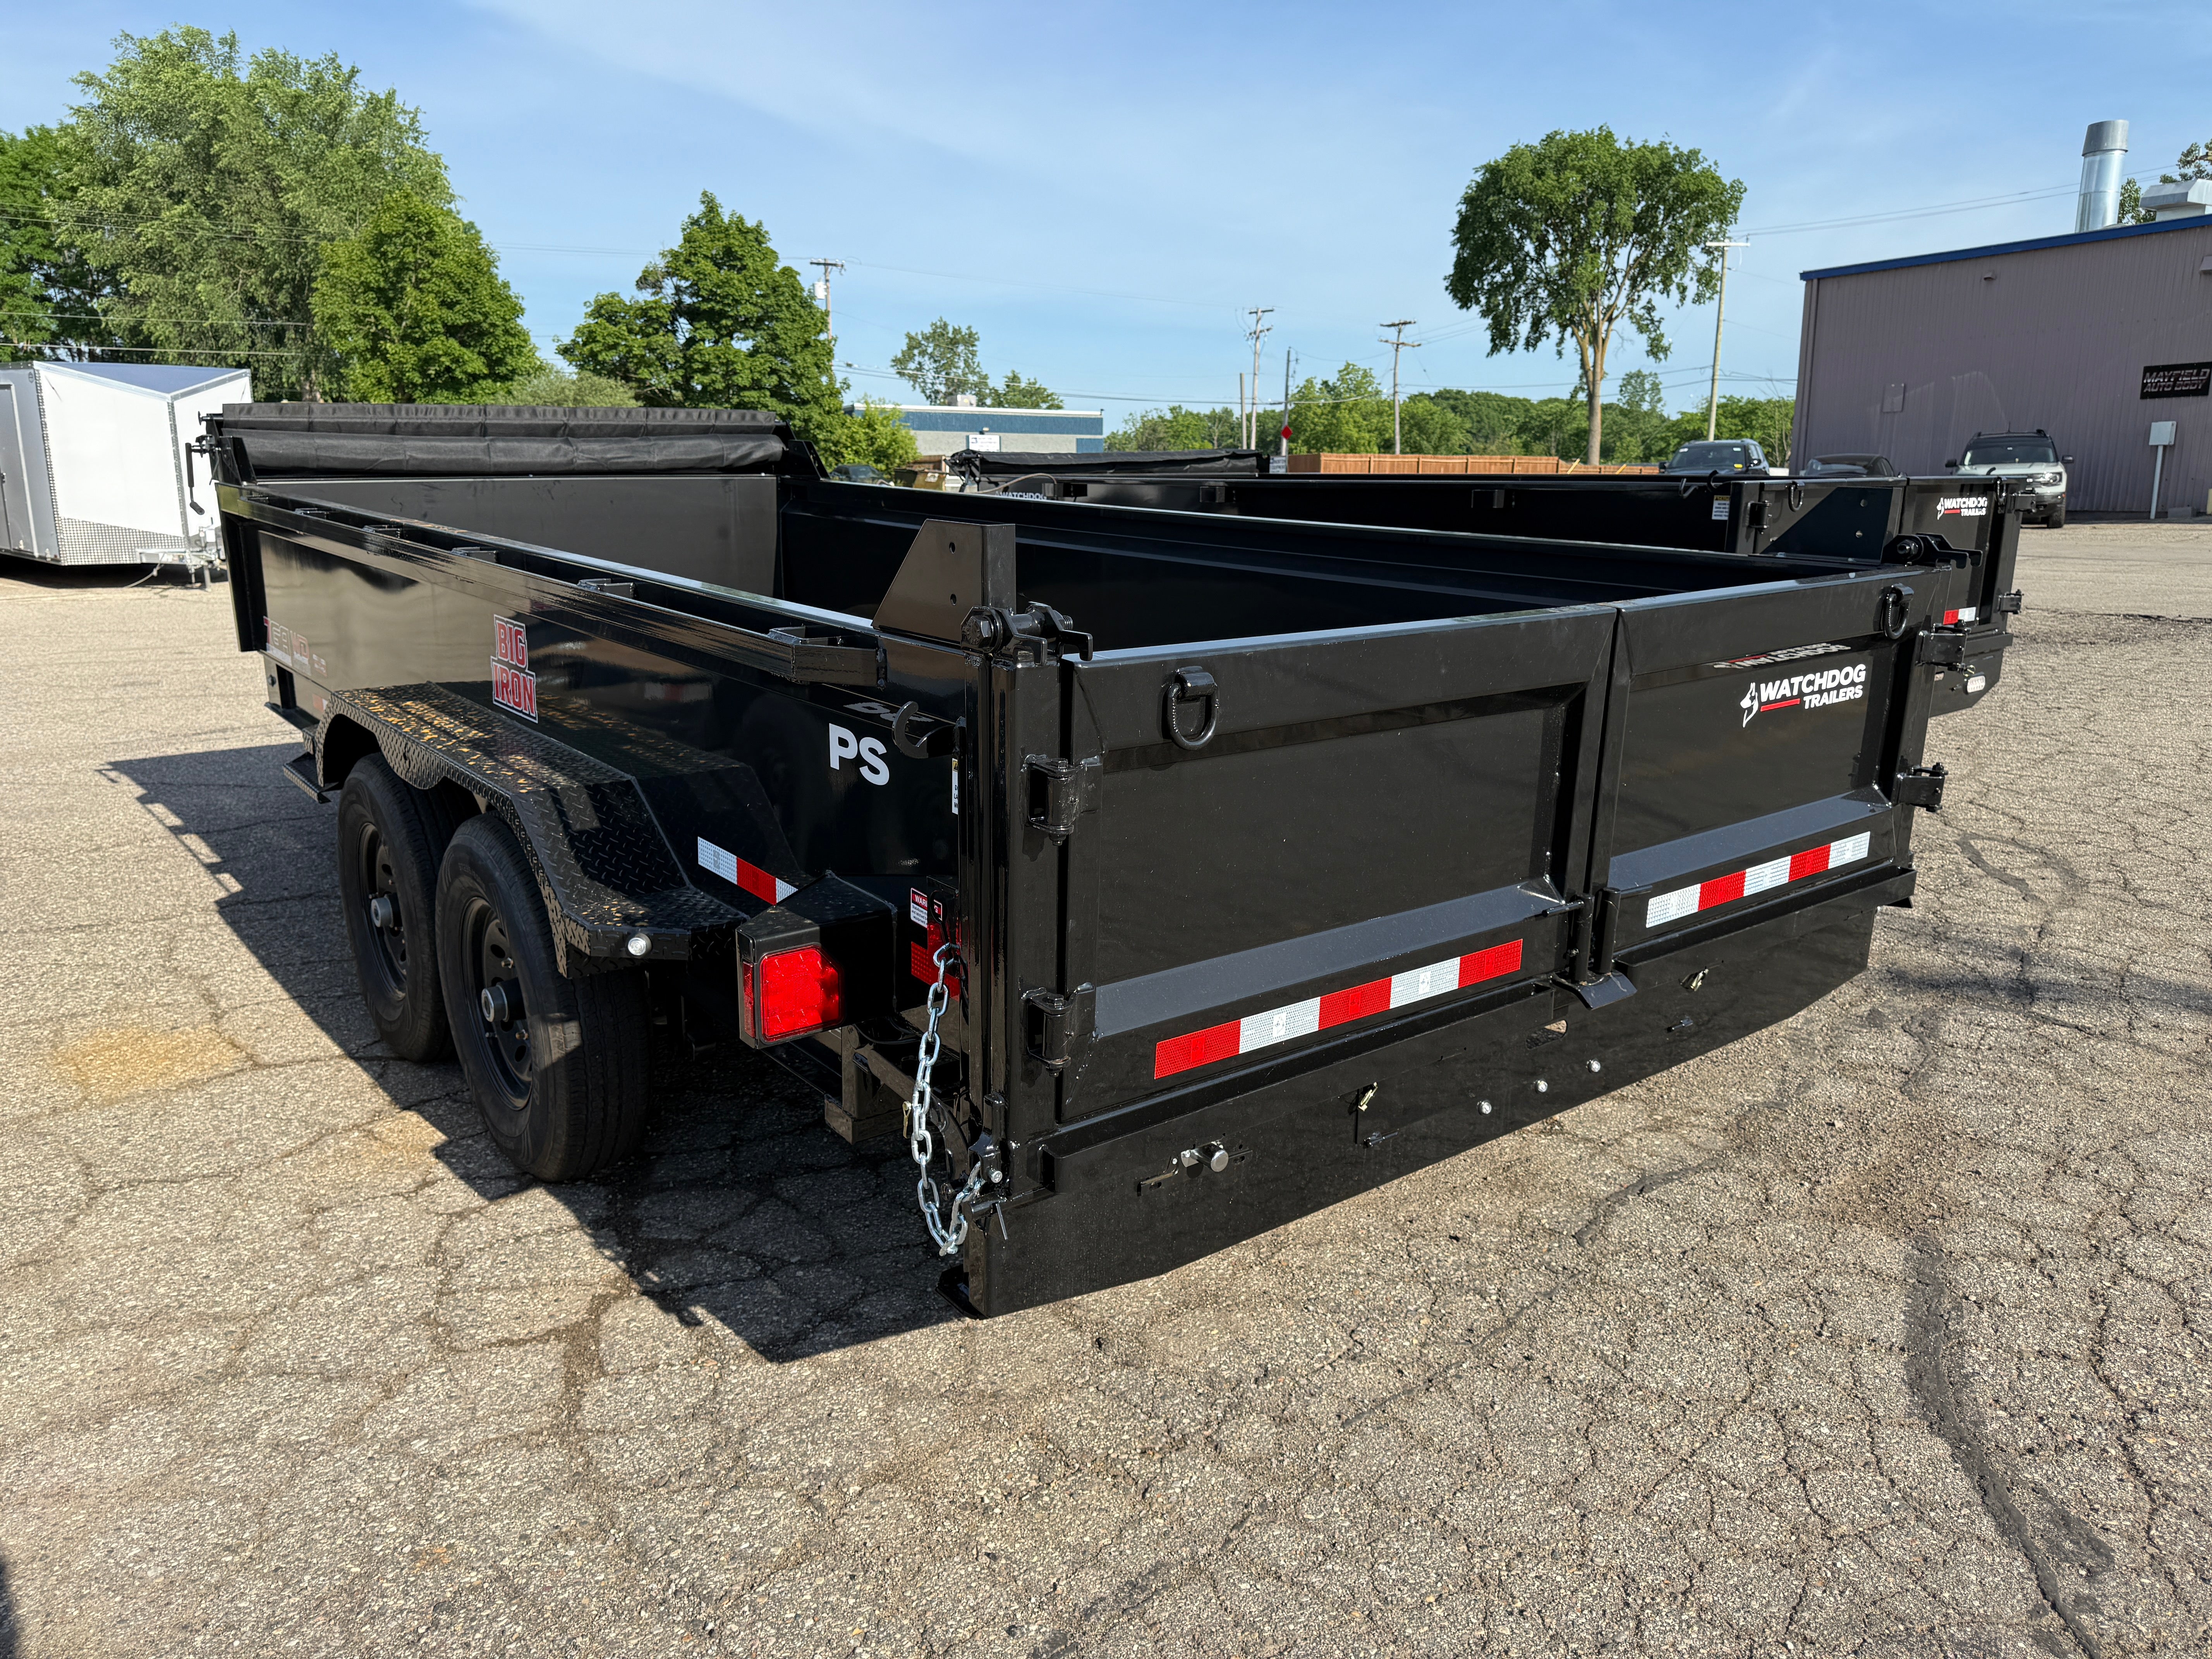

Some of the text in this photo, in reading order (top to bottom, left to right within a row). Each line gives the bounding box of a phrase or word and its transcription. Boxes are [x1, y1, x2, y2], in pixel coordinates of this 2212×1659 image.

[2143, 369, 2210, 383] MAYFIELD
[2143, 379, 2207, 392] AUTO BODY
[1944, 497, 1988, 509] WATCHDOG
[496, 620, 527, 668] BIG
[492, 662, 536, 716] IRON
[1760, 664, 1866, 702] WATCHDOG
[1803, 685, 1863, 709] TRAILERS
[829, 723, 890, 785] PS
